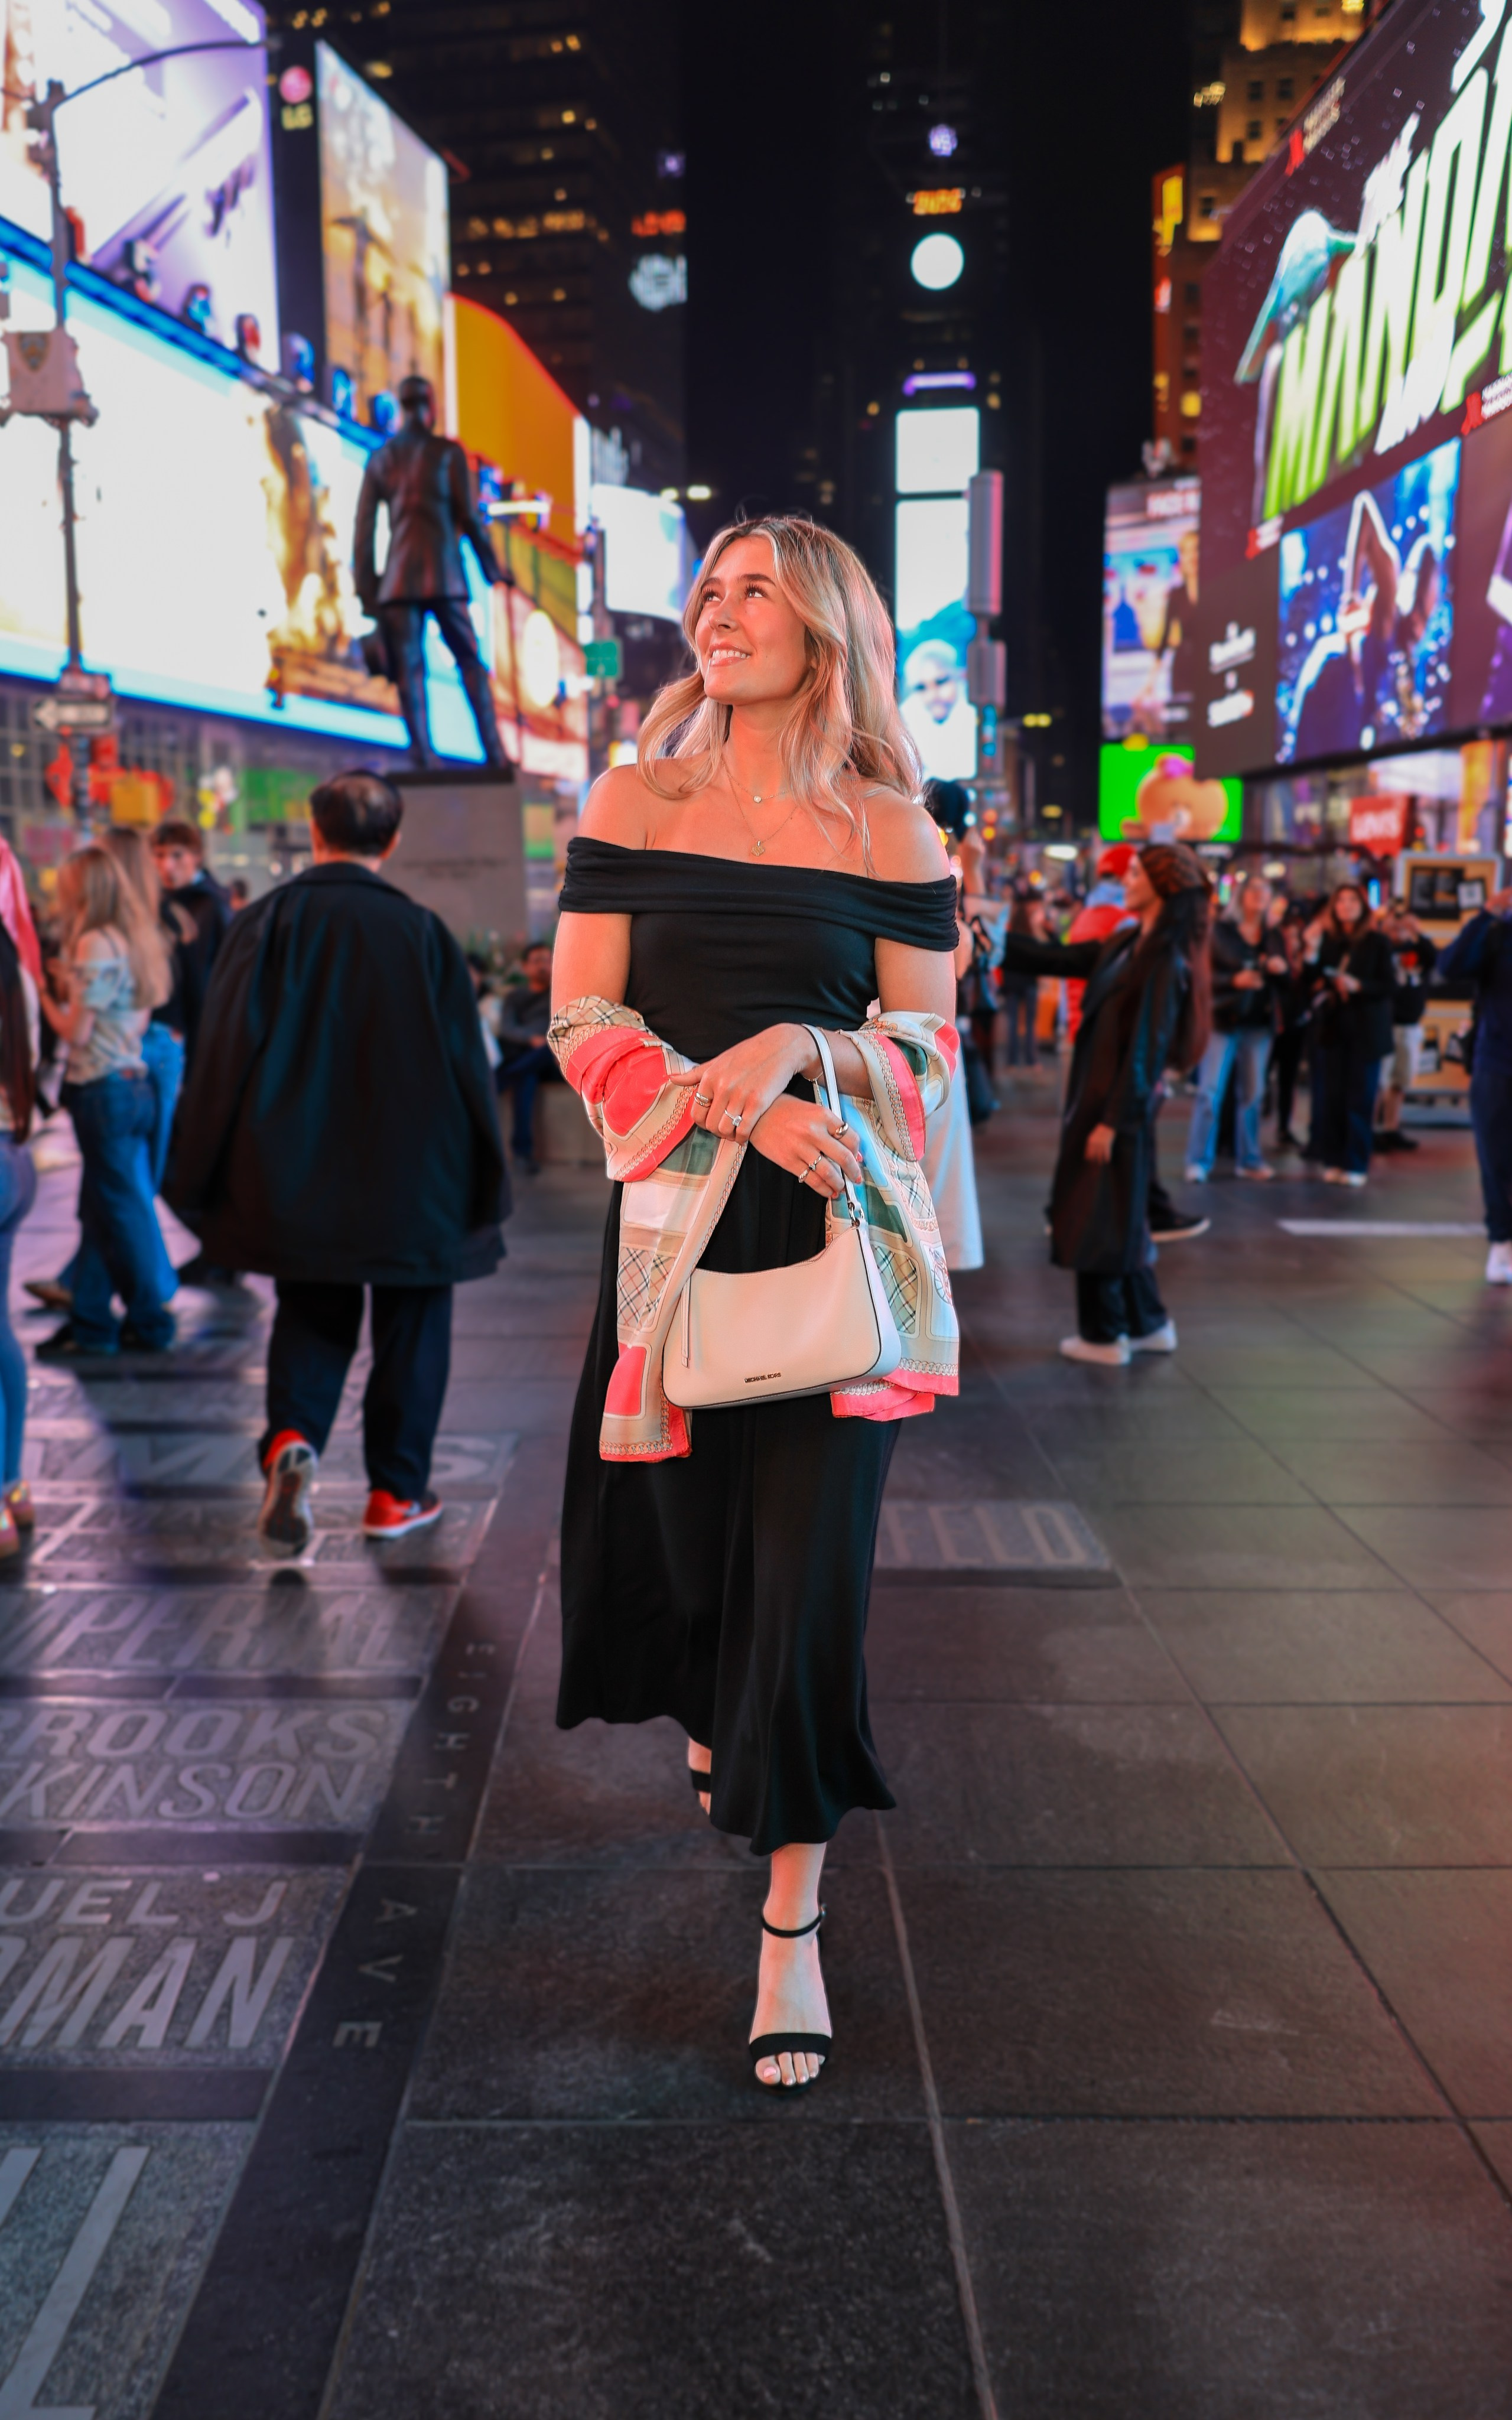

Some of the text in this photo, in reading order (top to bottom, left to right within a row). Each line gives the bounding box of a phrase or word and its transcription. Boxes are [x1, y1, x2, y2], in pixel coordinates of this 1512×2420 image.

[282, 103, 313, 129] LG
[745, 1375, 766, 1383] MICHAEL
[874, 1505, 1086, 1564] FELD
[0, 1762, 369, 1819] KINSON
[222, 1881, 288, 1927] J
[332, 1897, 418, 2049] AVE
